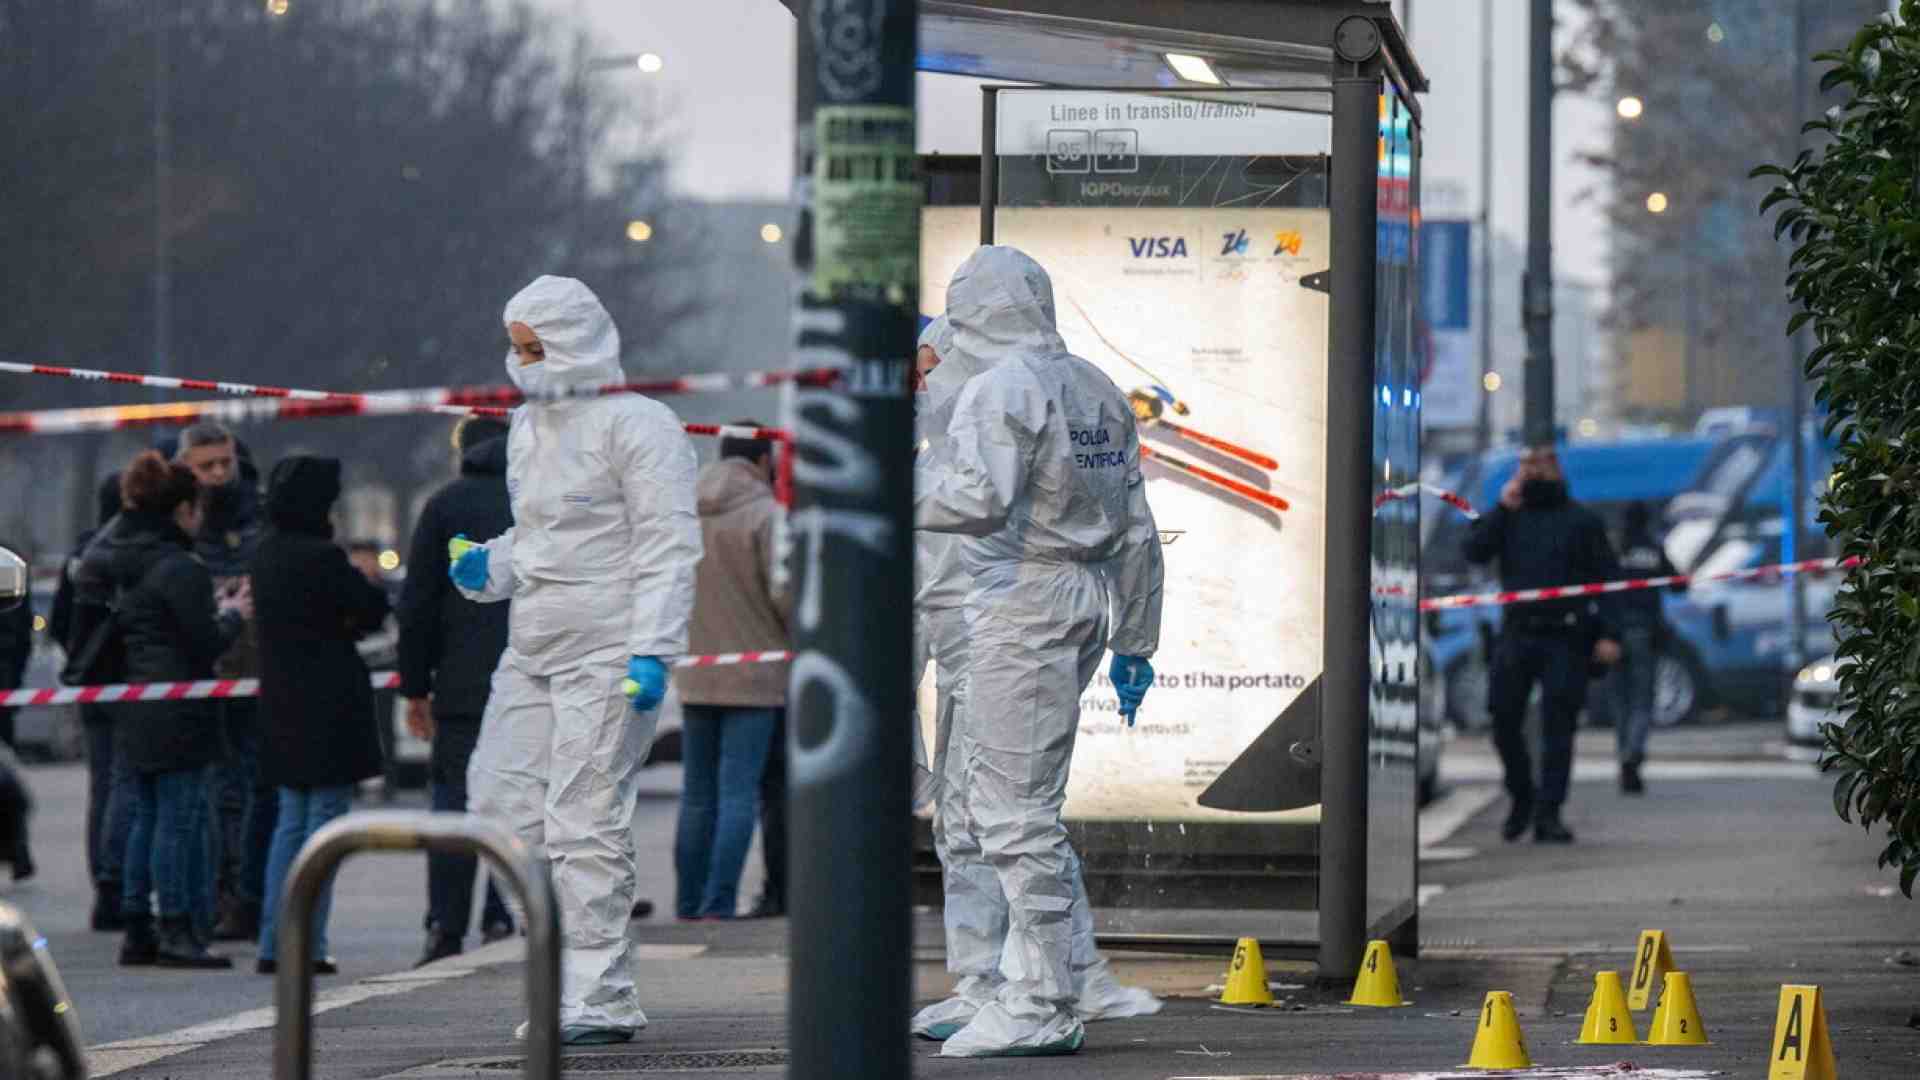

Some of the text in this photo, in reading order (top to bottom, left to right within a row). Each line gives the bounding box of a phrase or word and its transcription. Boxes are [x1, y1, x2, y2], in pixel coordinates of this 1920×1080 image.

[1051, 104, 1098, 121] Linee
[1105, 104, 1121, 120] in
[1056, 142, 1128, 161] 95 77
[1129, 236, 1188, 258] VISA
[1184, 672, 1197, 689] ti
[1201, 672, 1225, 689] ha
[1228, 673, 1306, 692] portato
[1234, 946, 1247, 971] 5
[1366, 948, 1378, 974] 4
[1635, 936, 1654, 990] B
[1485, 999, 1494, 1027] 1
[1608, 1017, 1618, 1033] 3
[1679, 1018, 1688, 1034] 2
[1778, 993, 1802, 1061] A
